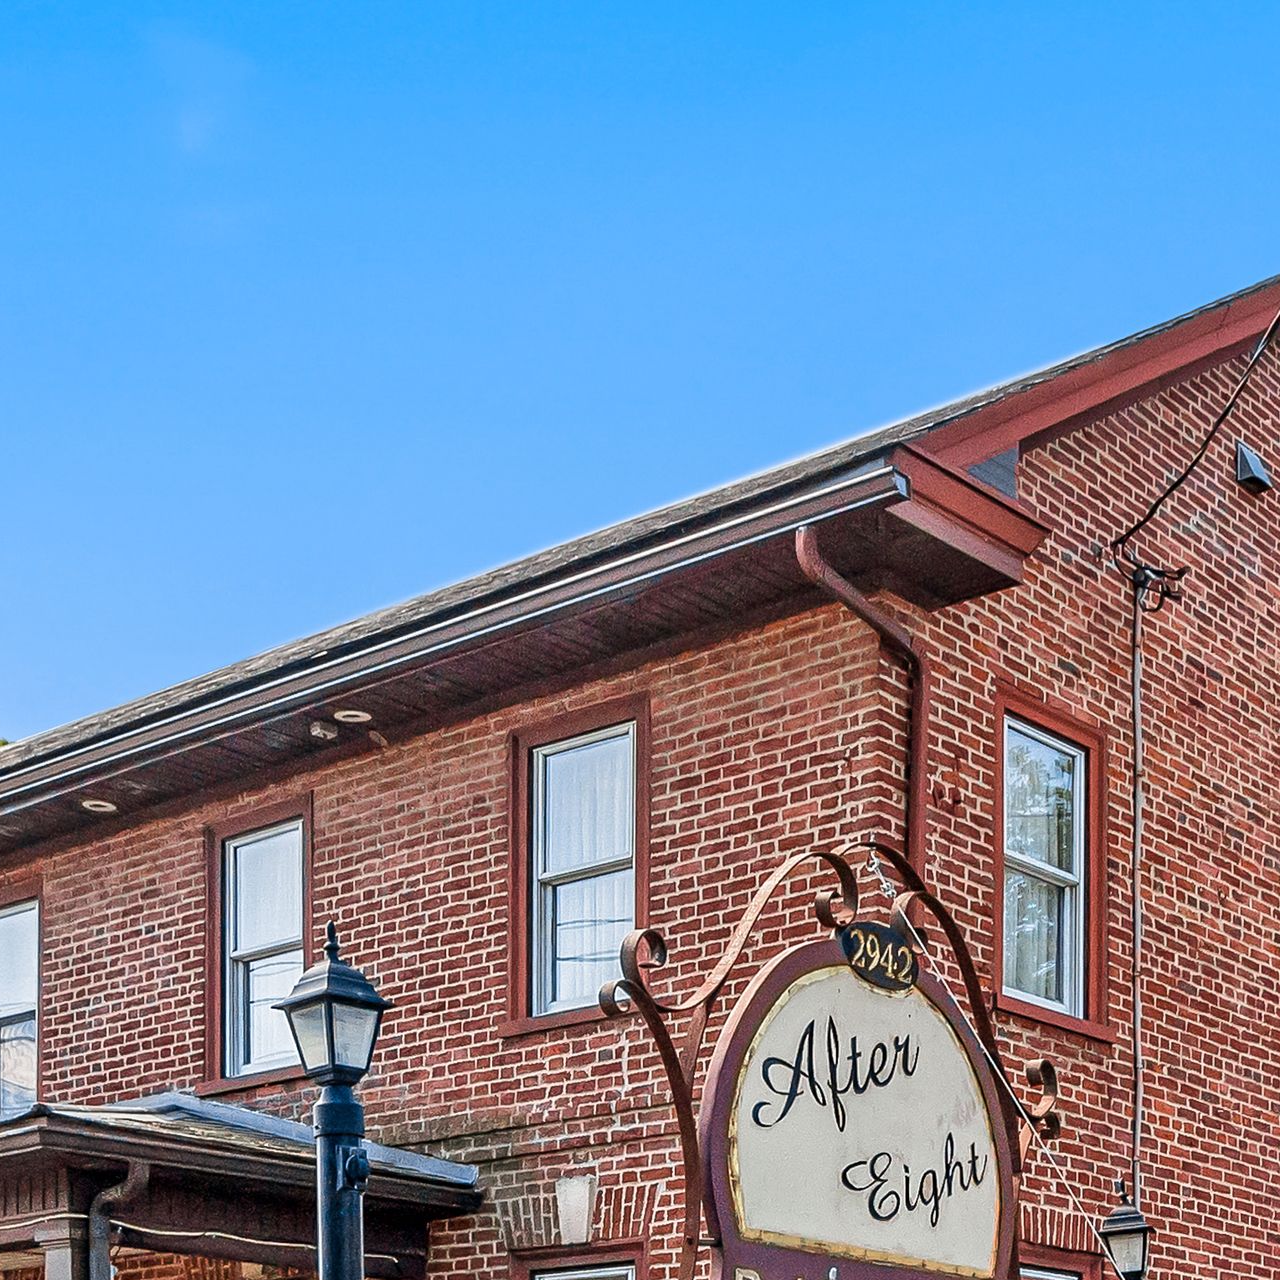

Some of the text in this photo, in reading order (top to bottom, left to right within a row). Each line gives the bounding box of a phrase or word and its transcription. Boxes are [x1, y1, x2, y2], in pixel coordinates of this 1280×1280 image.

[851, 928, 915, 983] 2942
[751, 1014, 920, 1133] After
[840, 1132, 989, 1228] Eight
